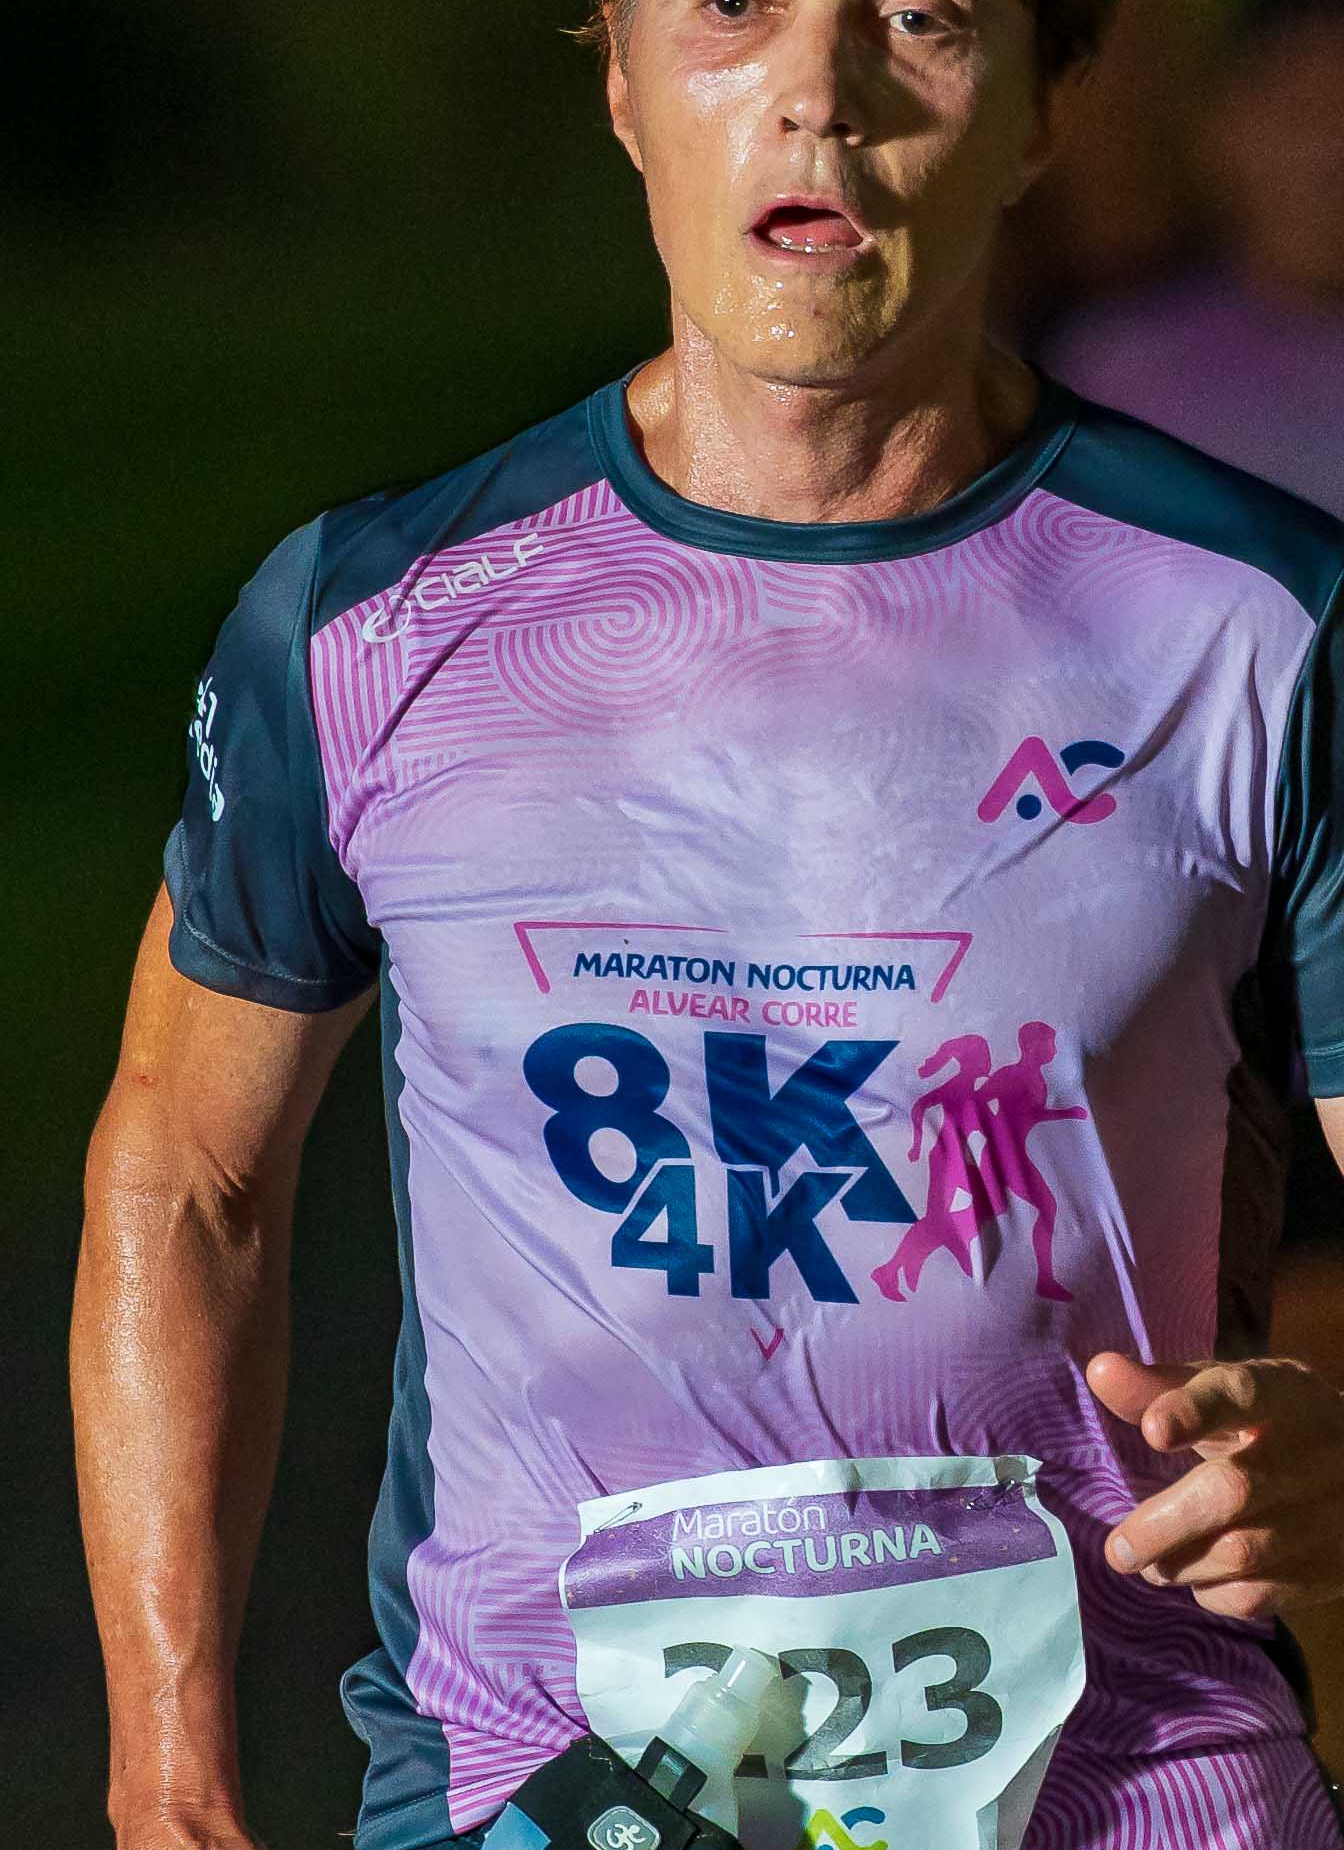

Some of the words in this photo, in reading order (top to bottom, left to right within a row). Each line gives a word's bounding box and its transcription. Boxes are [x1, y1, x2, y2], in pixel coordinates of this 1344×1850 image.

[572, 952, 737, 987] MARATON
[746, 962, 917, 992] NOCTURNA
[627, 988, 751, 1025] ALVEAR
[761, 999, 859, 1029] CORRE
[522, 1022, 919, 1224] 8K
[611, 1164, 861, 1305] 4K
[671, 1496, 826, 1542] Maratón
[670, 1523, 943, 1581] NOCTURNA
